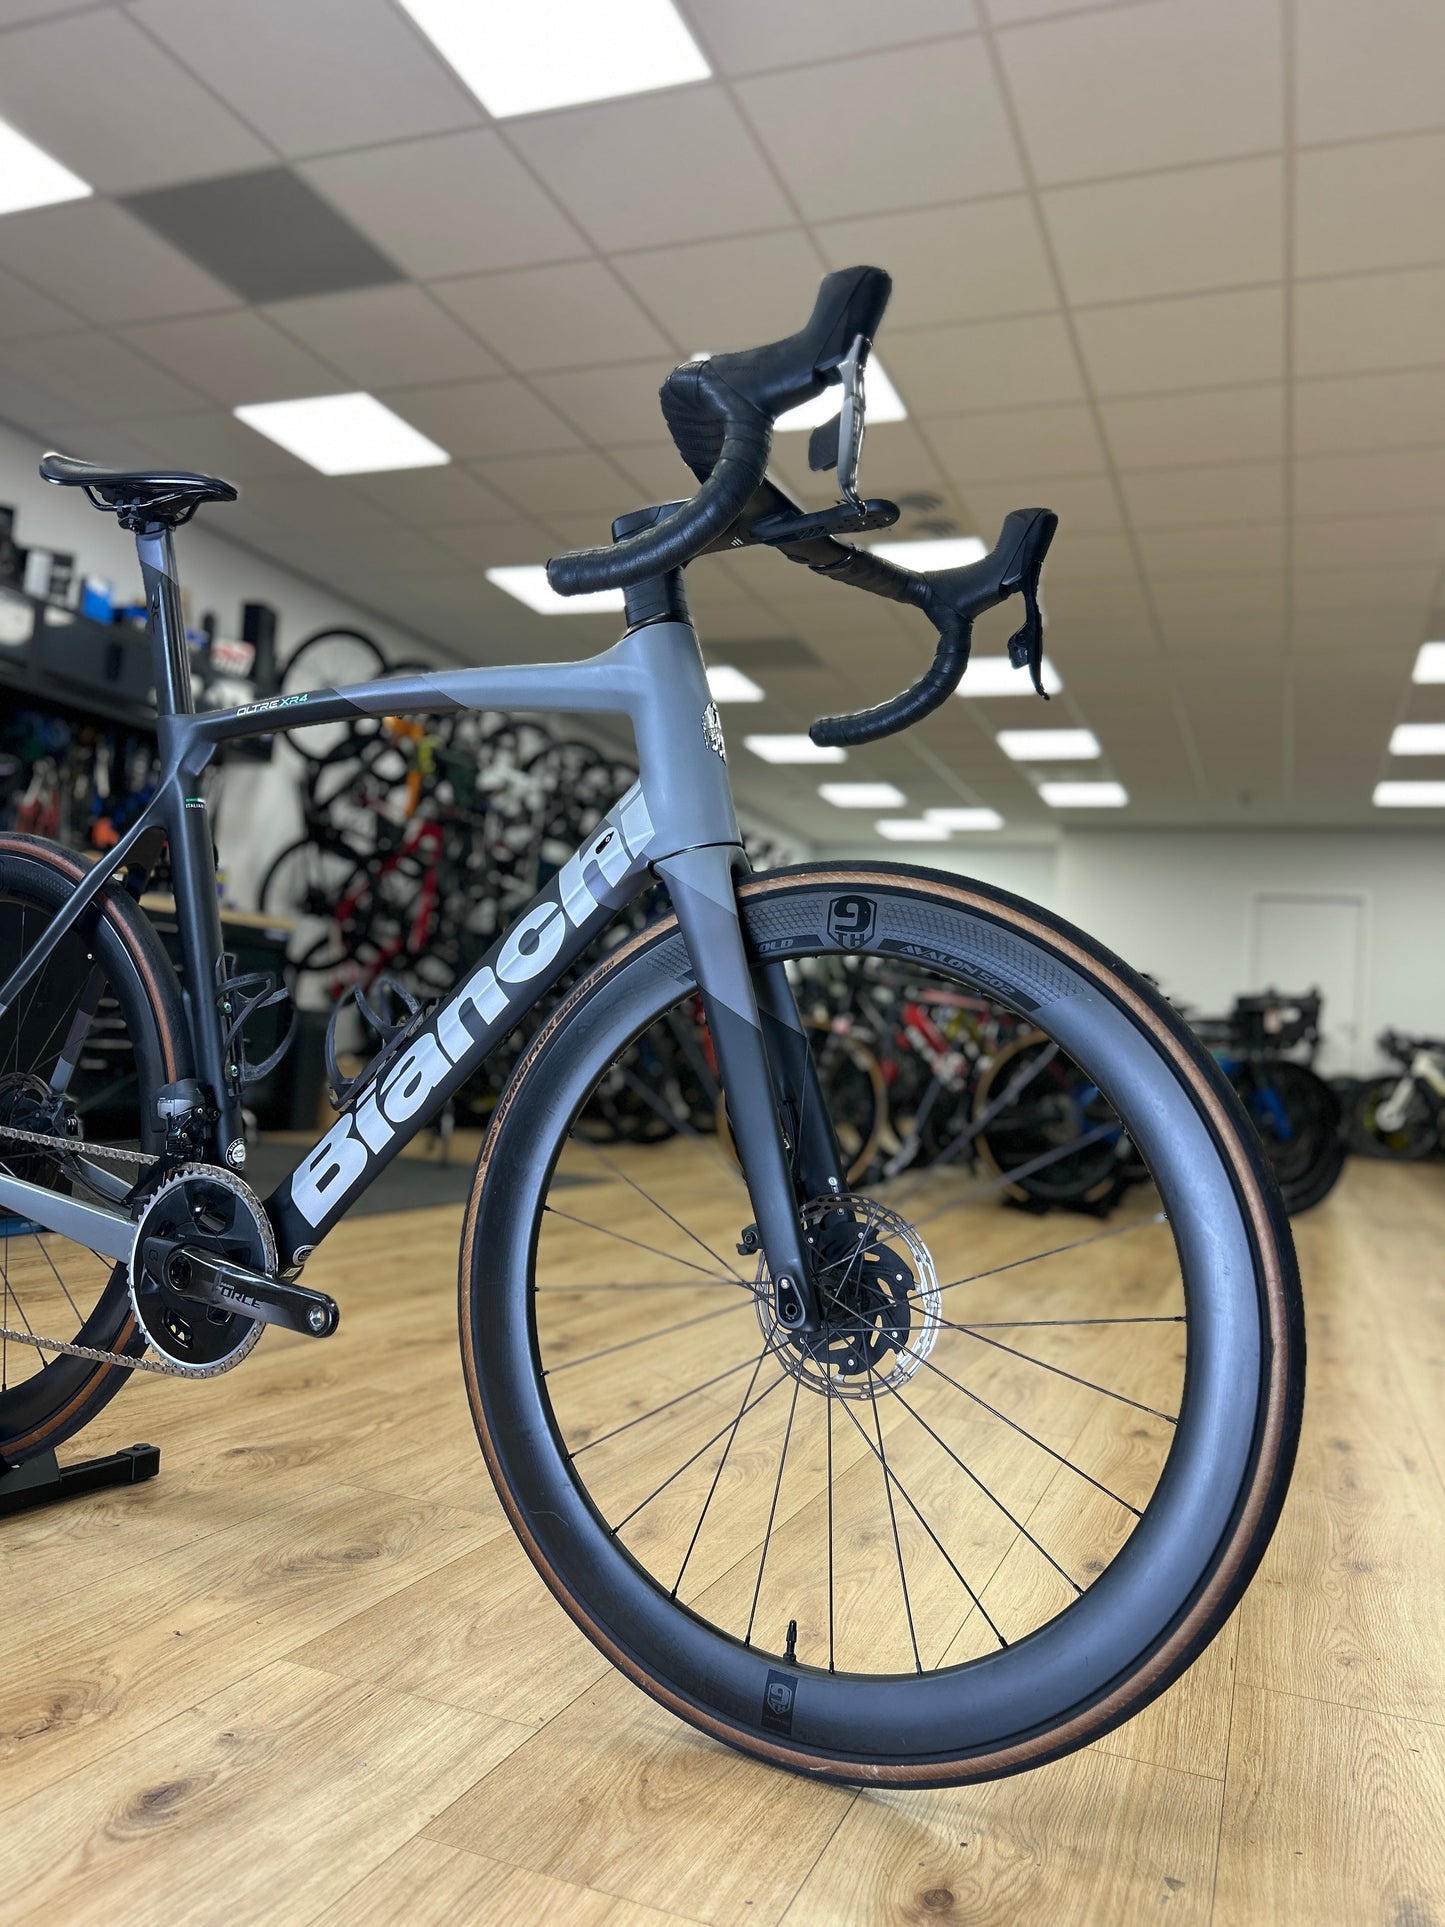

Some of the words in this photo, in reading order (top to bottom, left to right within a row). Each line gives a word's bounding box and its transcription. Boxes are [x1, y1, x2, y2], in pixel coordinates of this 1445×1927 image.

[236, 700, 280, 716] OLTRE
[280, 694, 308, 707] XR4
[834, 895, 871, 932] 9
[834, 931, 865, 947] TH
[899, 945, 978, 976] AVALON
[977, 970, 1016, 996] 502
[291, 779, 656, 1229] Bianchi
[497, 1062, 529, 1123] GRAND
[527, 1019, 556, 1063] PRIX
[217, 1286, 261, 1309] ORCE
